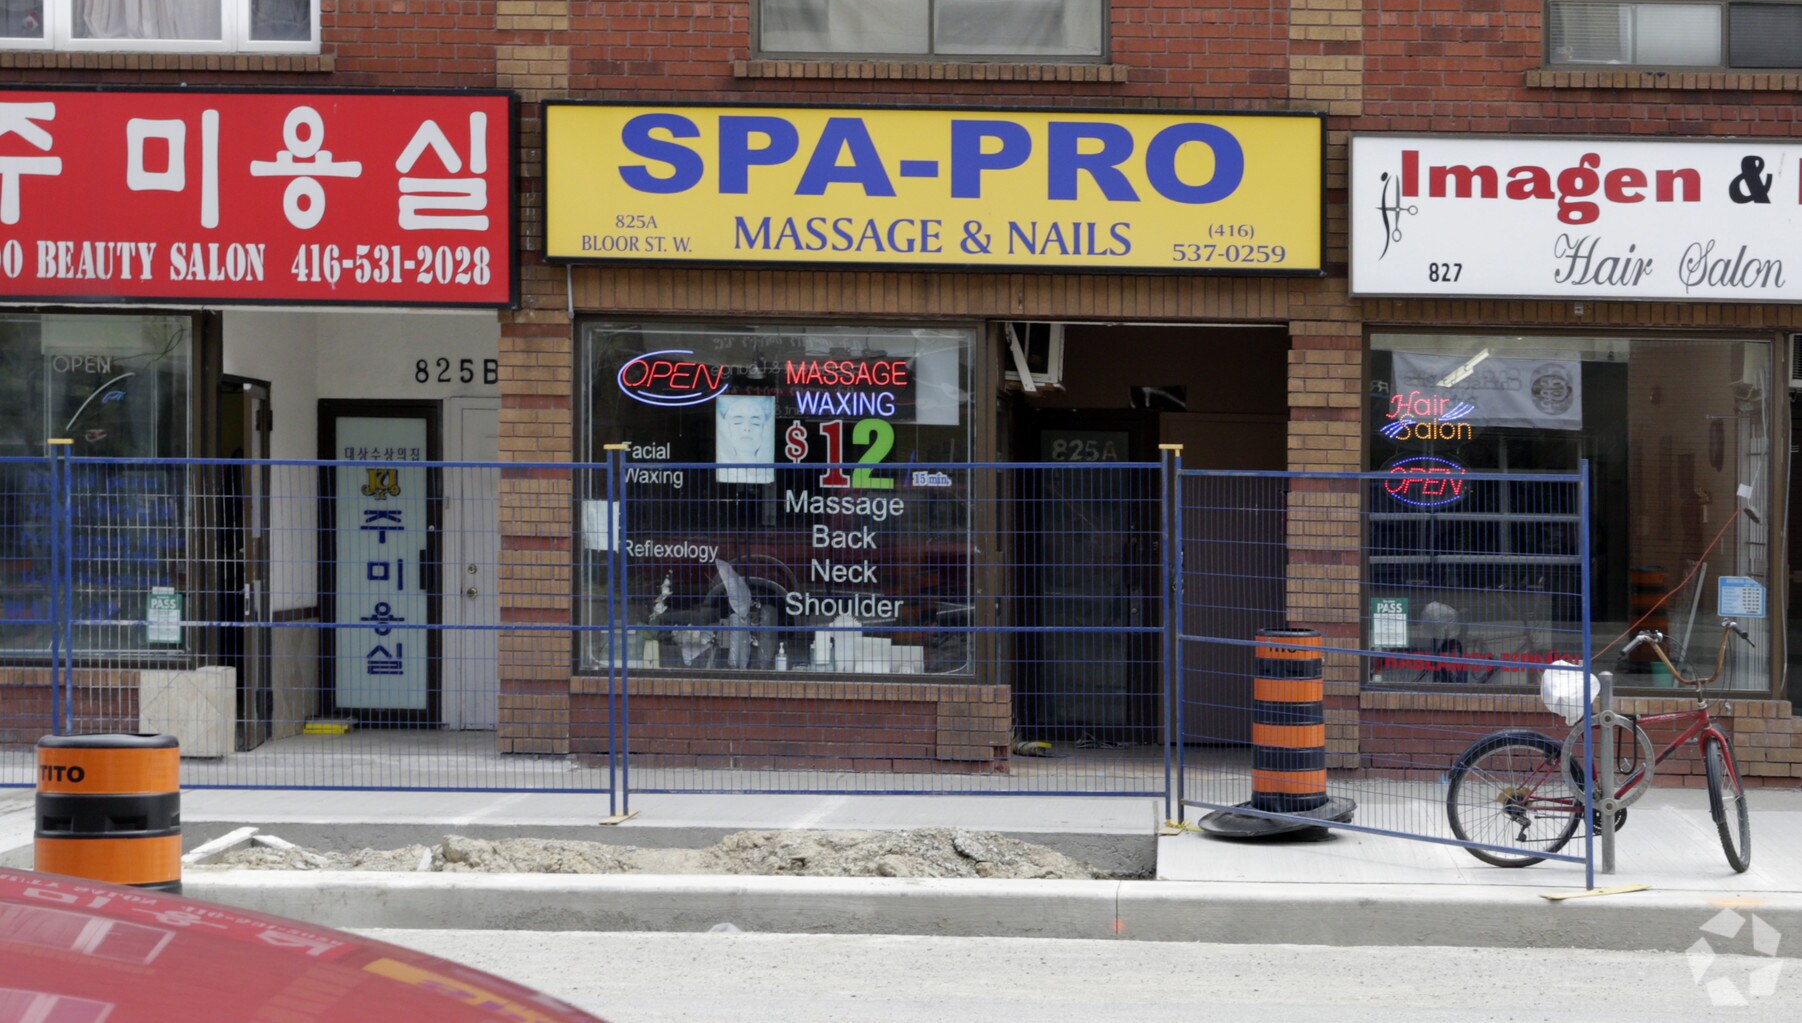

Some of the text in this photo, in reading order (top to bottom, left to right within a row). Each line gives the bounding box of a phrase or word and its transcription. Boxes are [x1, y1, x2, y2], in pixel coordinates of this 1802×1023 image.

[618, 113, 1244, 204] SPA-PRO
[1401, 150, 1701, 225] Imagen
[1728, 155, 1773, 204] &
[615, 214, 658, 229] 825A
[1207, 223, 1255, 239] (416)
[581, 235, 693, 253] BLOOR ST. W.
[734, 216, 1132, 256] MASSAGE & NAILS
[36, 240, 157, 281] BEAUTY
[170, 242, 266, 282] SALON
[291, 243, 491, 286] 416-531-2028
[1172, 243, 1286, 263] 537-0259
[1553, 233, 1785, 294] Hair Salon
[1428, 262, 1463, 283] 827
[415, 358, 498, 384] 825B
[621, 360, 724, 390] OPEN
[786, 360, 908, 386] MASSAGE
[796, 391, 896, 417] WAXING
[1386, 391, 1450, 418] Hair
[1396, 413, 1472, 440] Salon
[625, 466, 684, 489] Waxing
[1385, 467, 1467, 495] OPEN
[785, 490, 905, 521] Massage
[812, 525, 877, 550] Back
[624, 540, 719, 562] Reflexology
[811, 558, 878, 584] Neck
[151, 599, 176, 610] PASS
[785, 591, 904, 619] Shoulder
[1377, 603, 1402, 613] PASS
[40, 765, 85, 783] TITO
